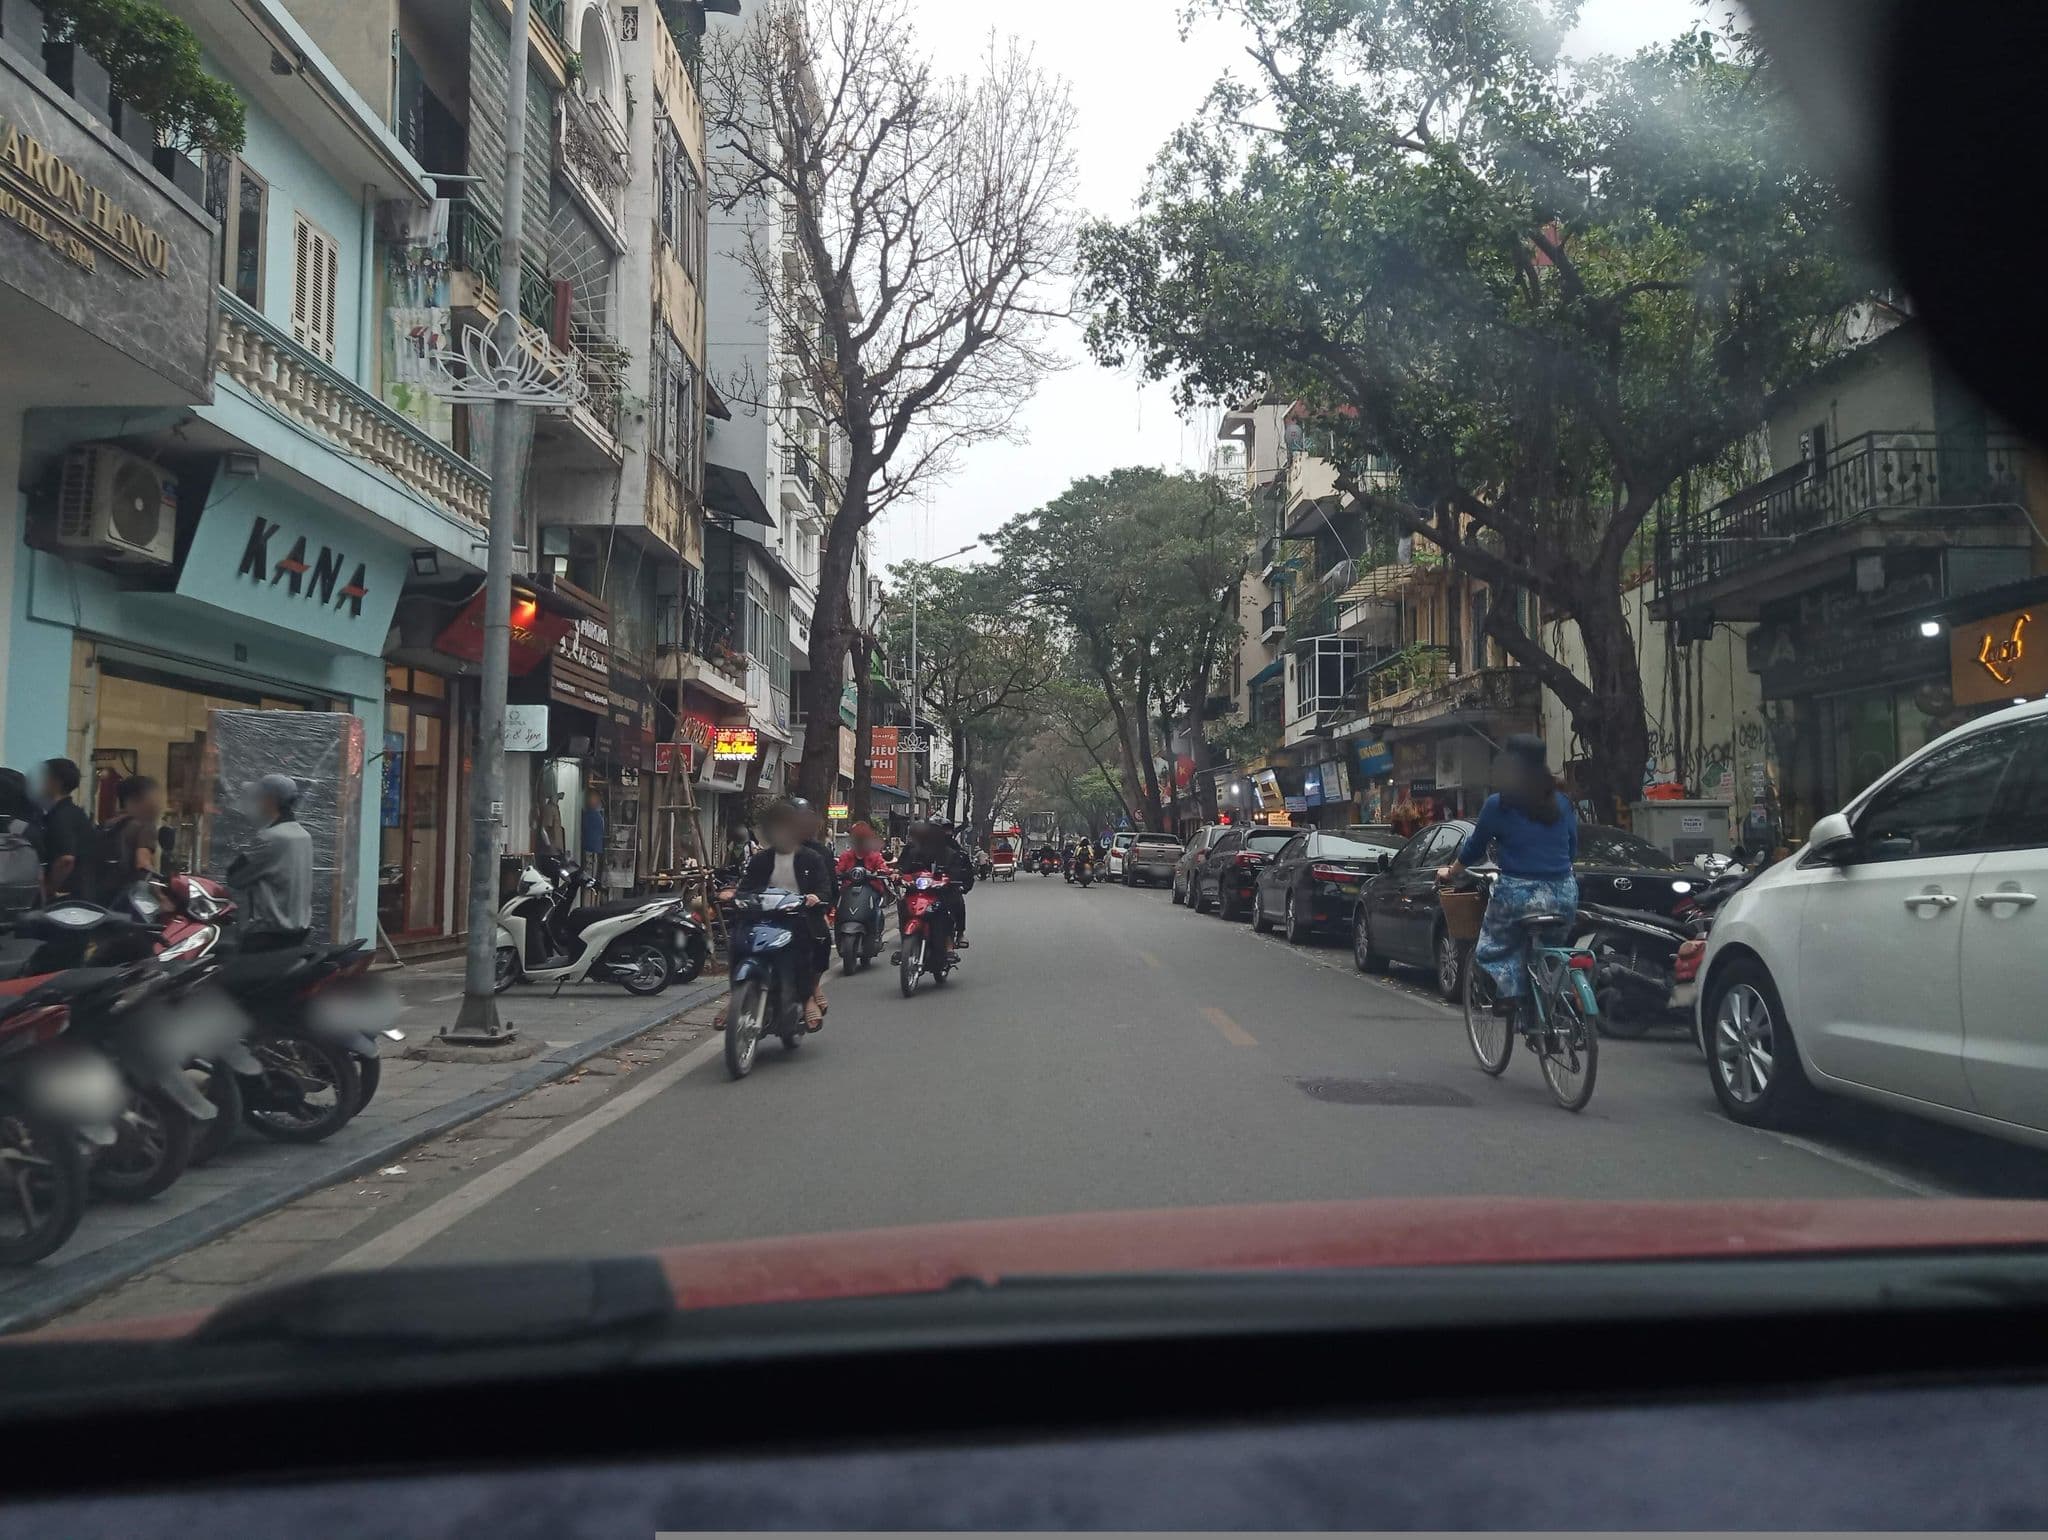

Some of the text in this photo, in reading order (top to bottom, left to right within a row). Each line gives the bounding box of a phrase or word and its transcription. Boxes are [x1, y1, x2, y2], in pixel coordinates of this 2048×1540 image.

[90, 187, 169, 277] HANOI
[68, 237, 96, 273] SPA
[238, 515, 369, 617] KANA
[871, 744, 896, 756] SIÊU
[872, 759, 893, 771] THỊ
